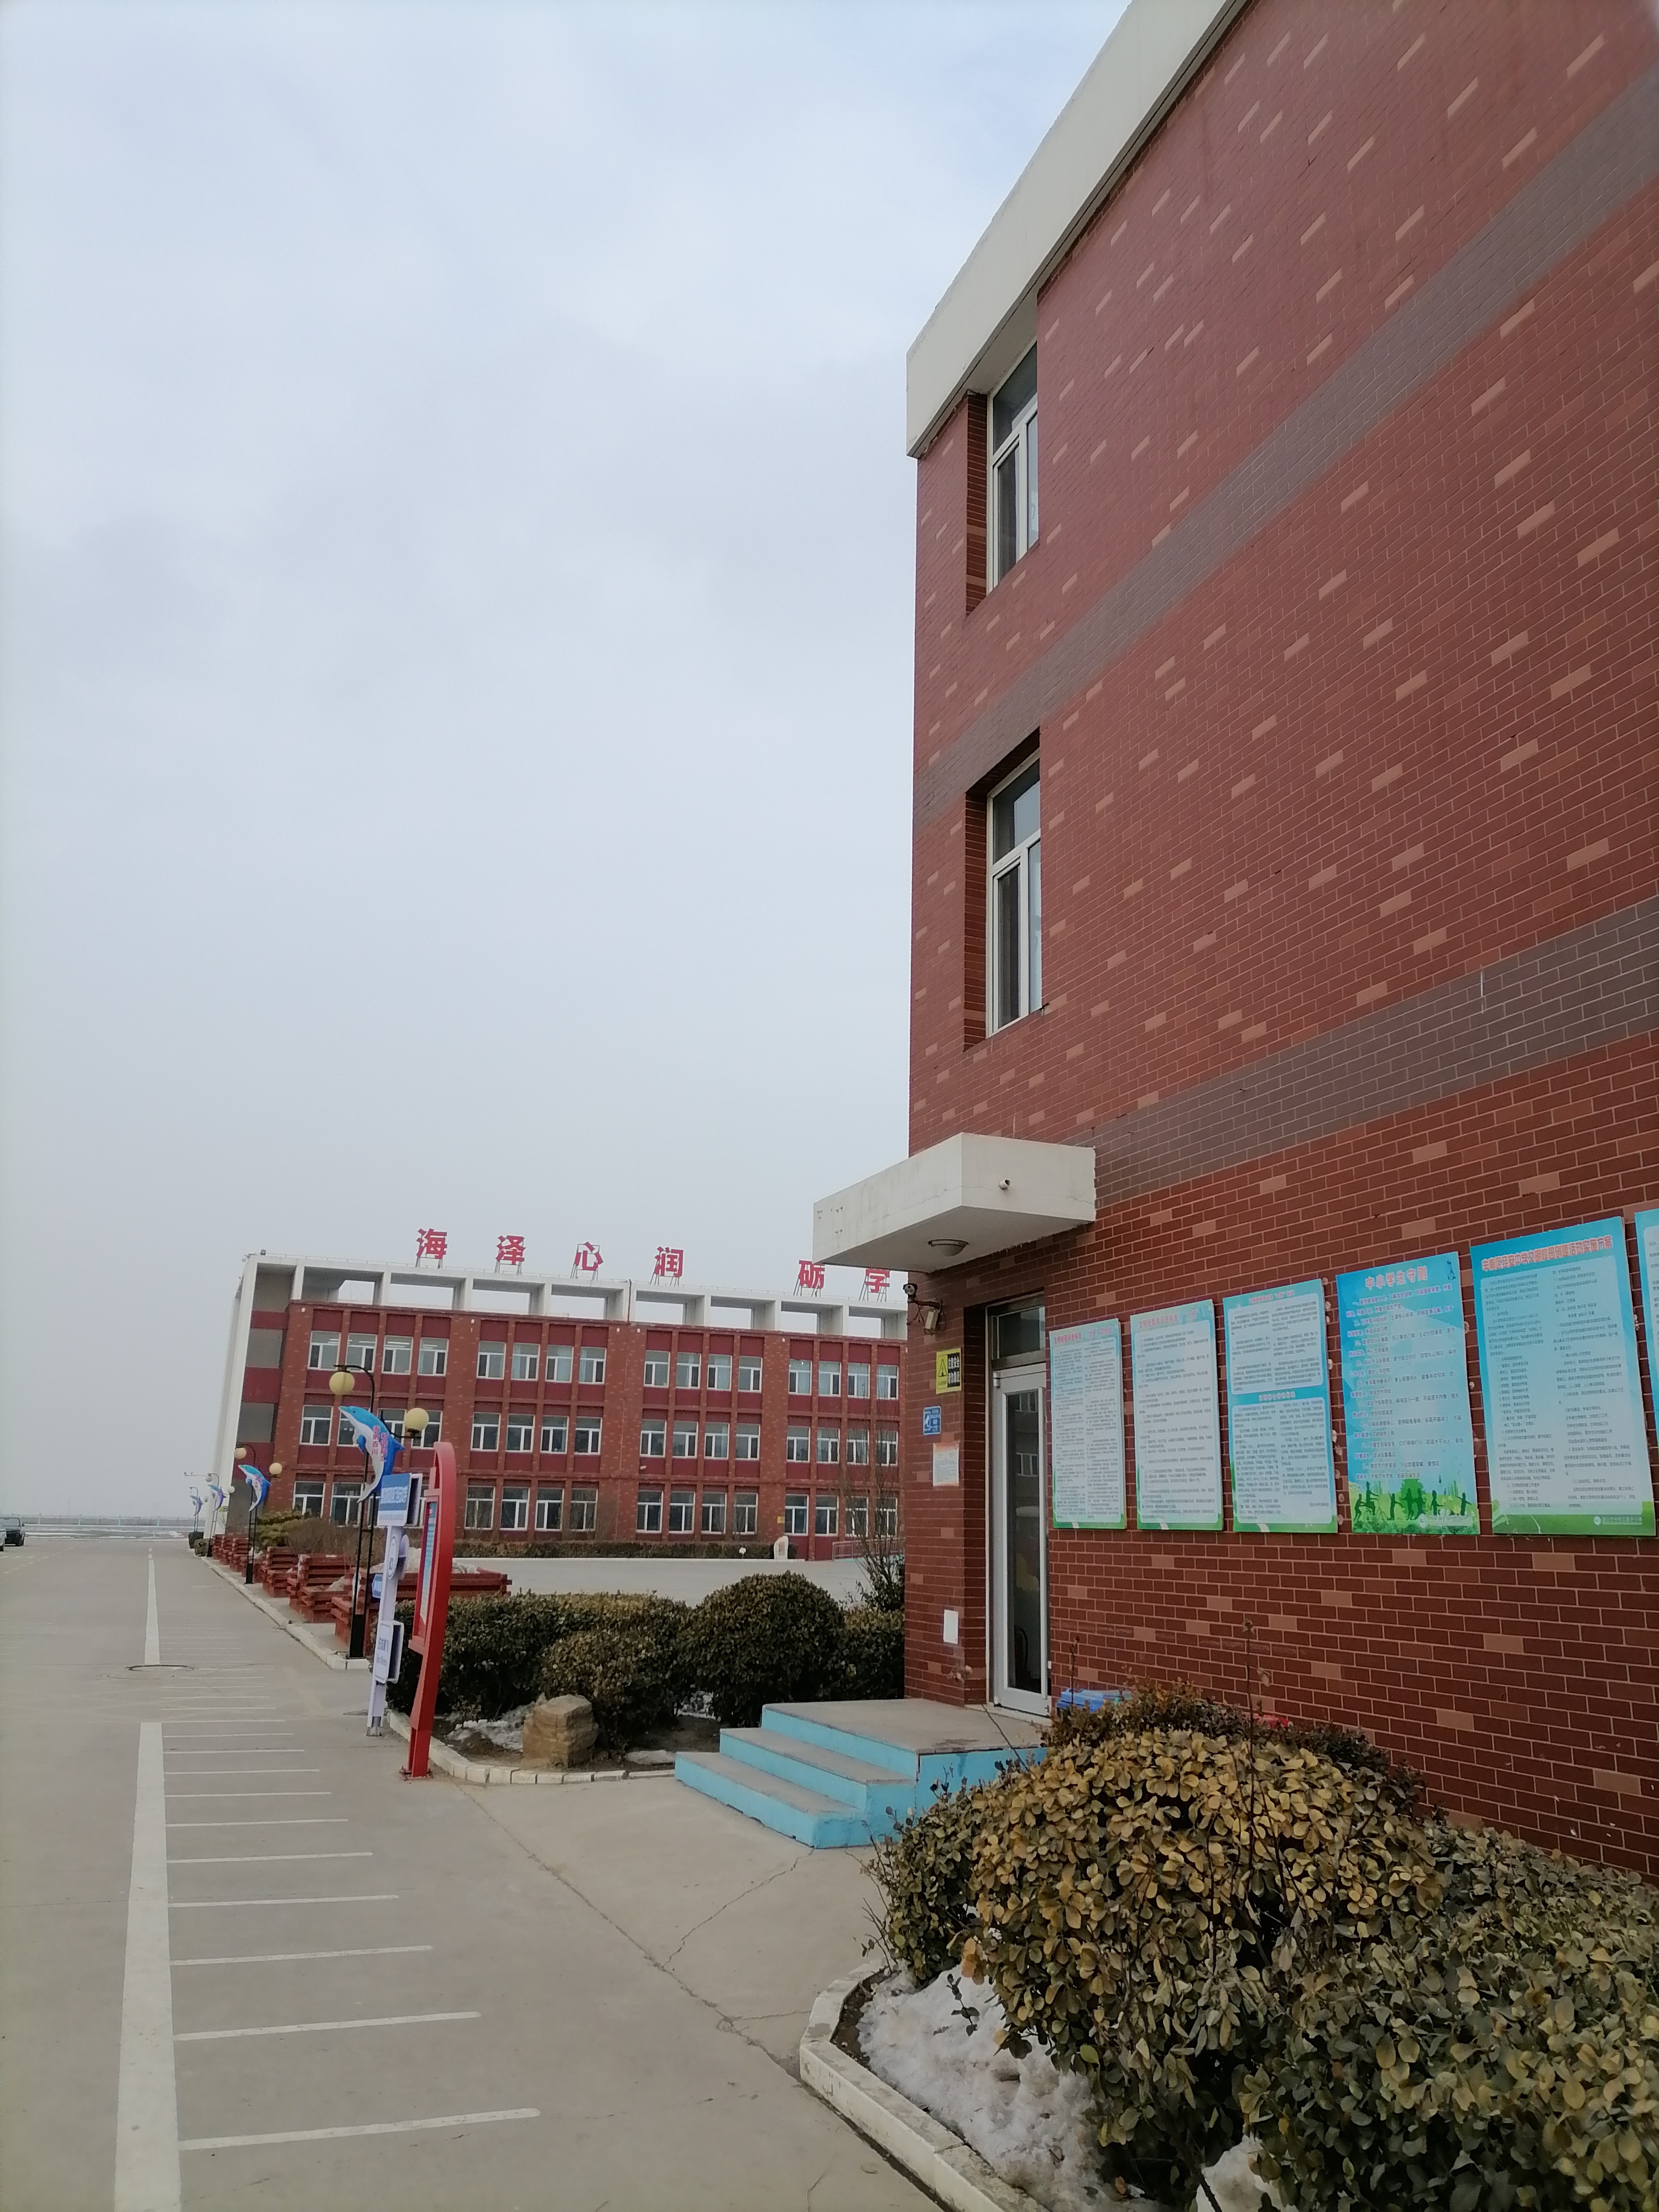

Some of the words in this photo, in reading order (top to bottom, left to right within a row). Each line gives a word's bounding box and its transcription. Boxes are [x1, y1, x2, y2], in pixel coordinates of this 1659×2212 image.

[1365, 1265, 1427, 1290] 中小学生守则
